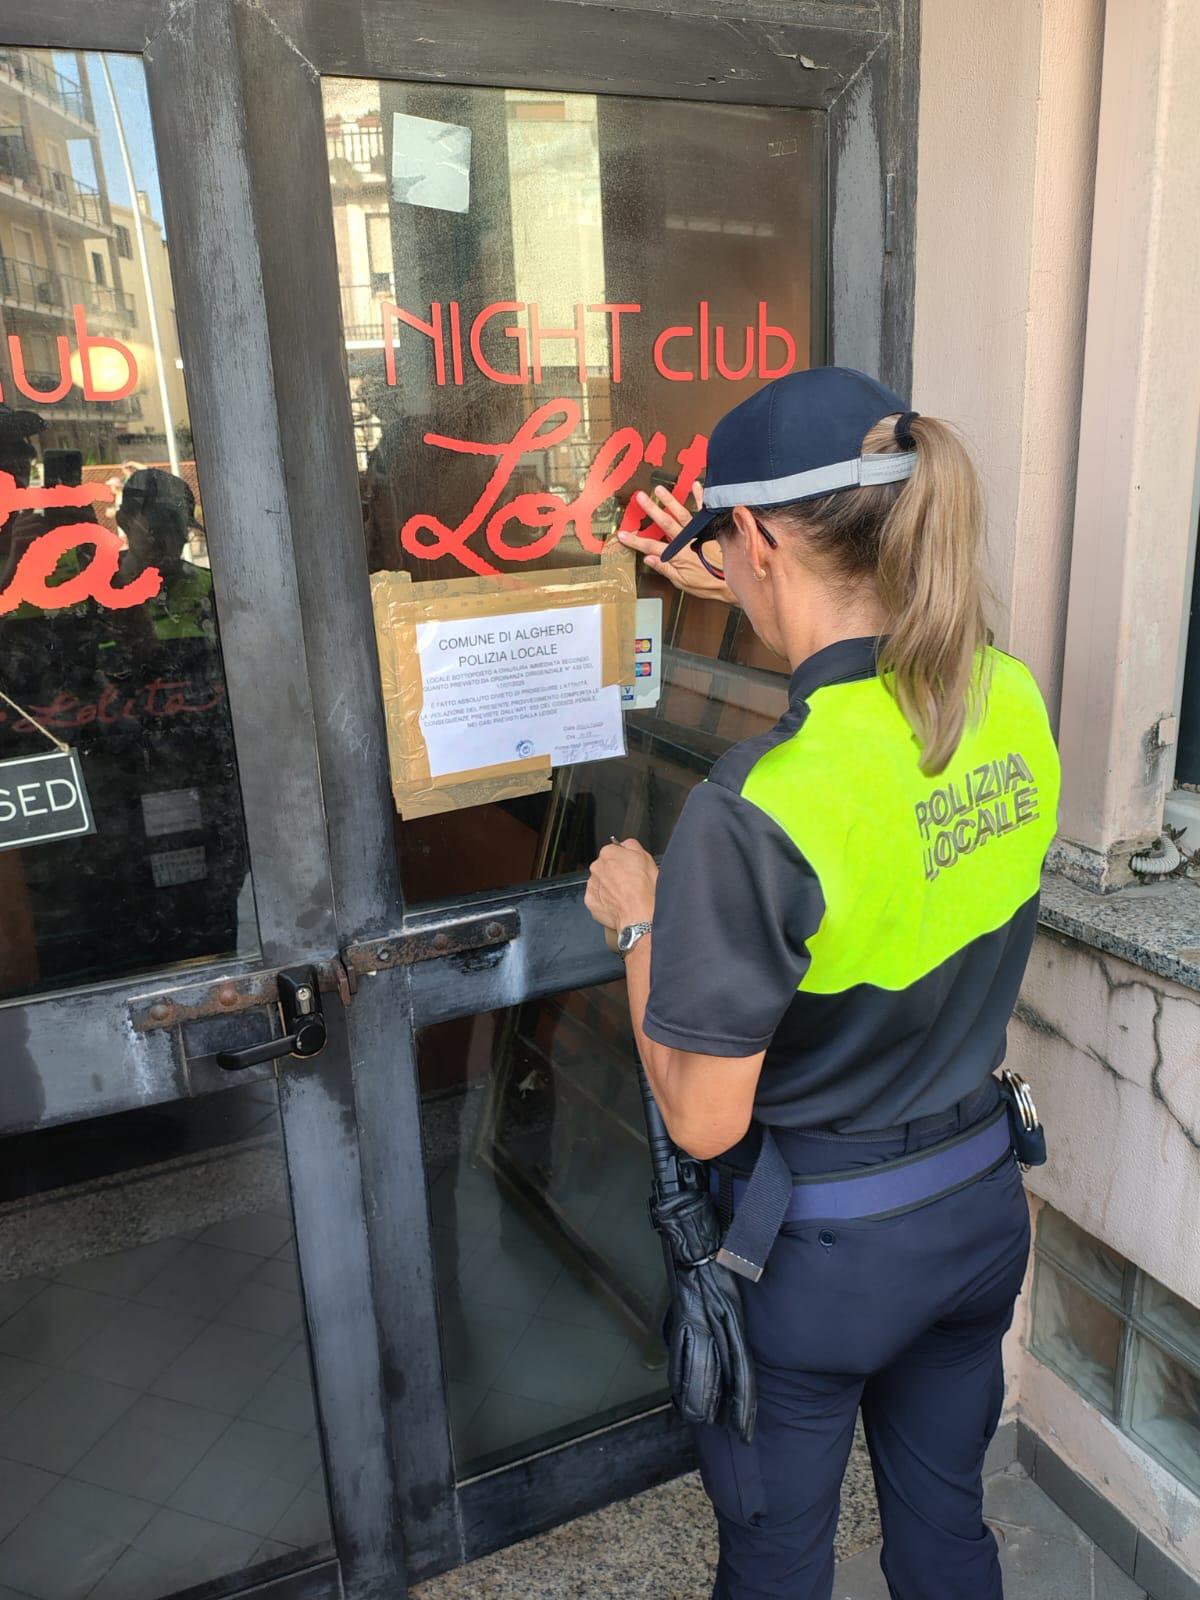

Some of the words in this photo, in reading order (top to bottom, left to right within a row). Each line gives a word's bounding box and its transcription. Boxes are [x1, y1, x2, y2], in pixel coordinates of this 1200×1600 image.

[0, 304, 138, 403] ub
[380, 301, 641, 387] NIGHT
[653, 301, 798, 381] club
[438, 632, 496, 651] COMUNE
[499, 631, 511, 643] DI
[515, 622, 574, 640] ALGHERO
[458, 651, 507, 667] POLIZIA
[511, 643, 558, 660] LOCALE
[914, 752, 1035, 841] POLIZIA
[923, 787, 1040, 882] LOCALE
